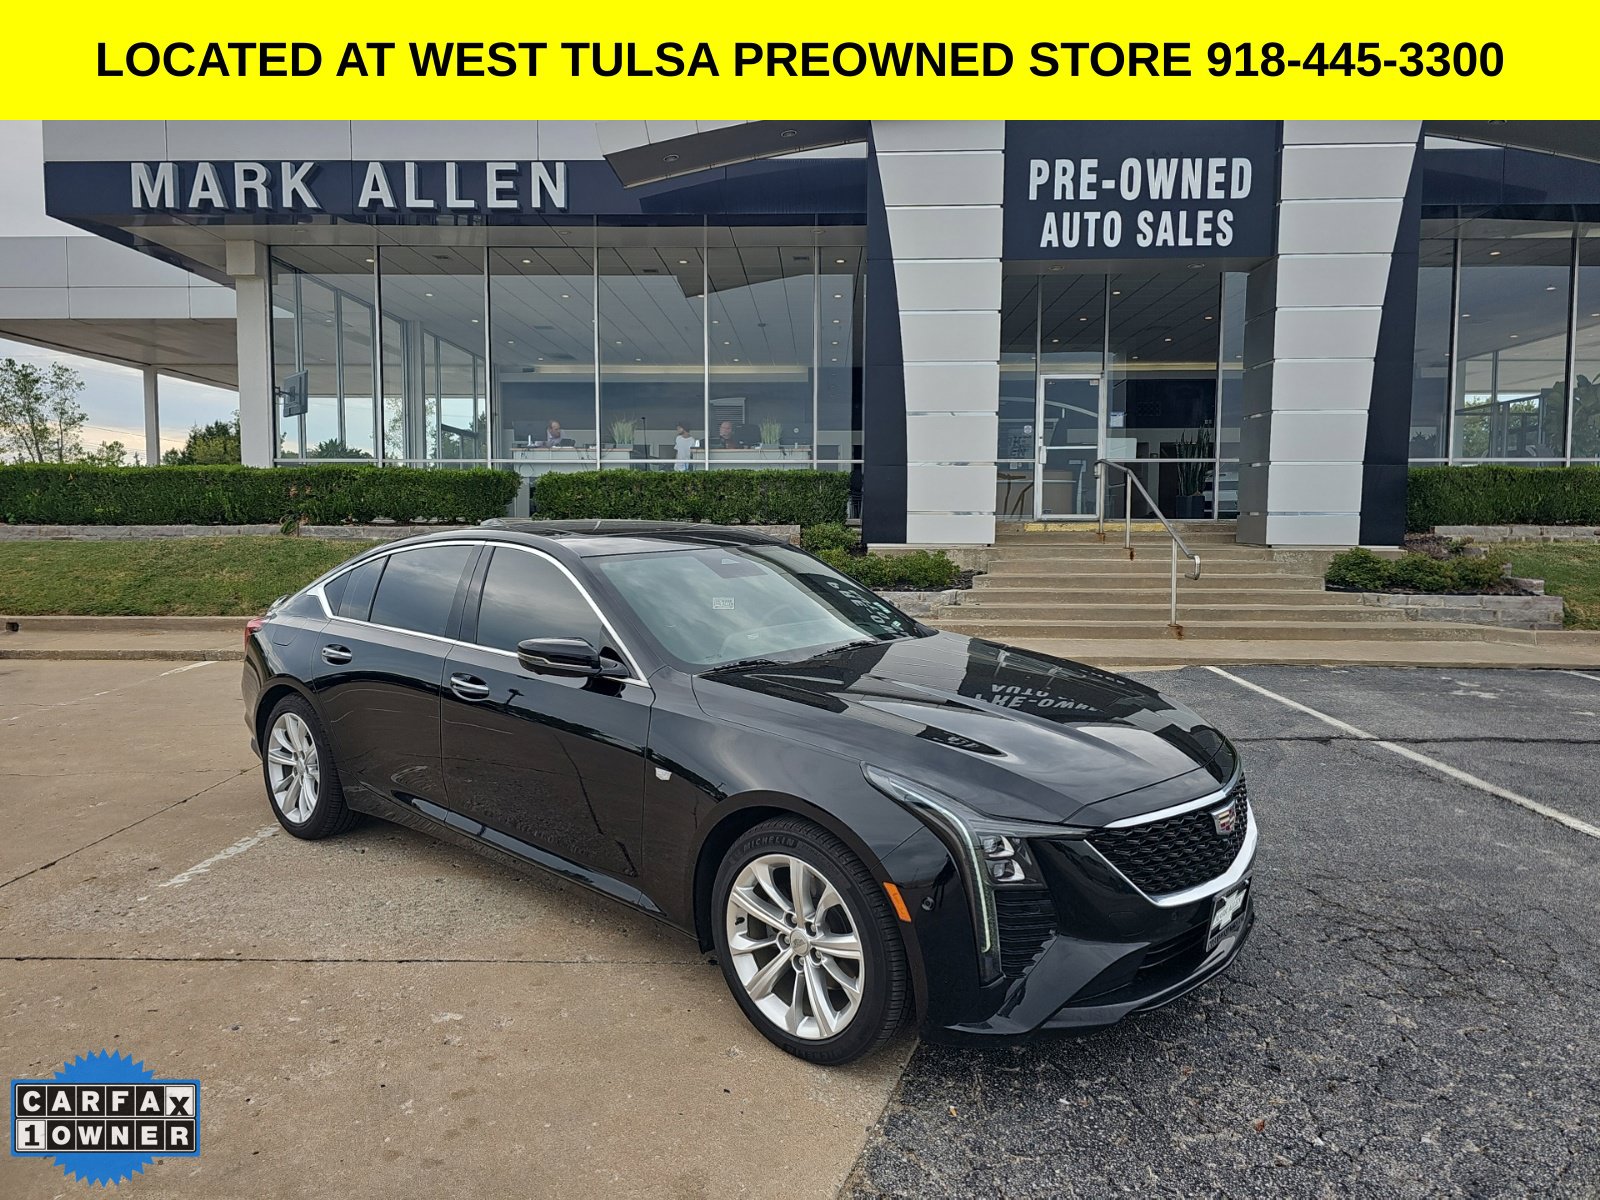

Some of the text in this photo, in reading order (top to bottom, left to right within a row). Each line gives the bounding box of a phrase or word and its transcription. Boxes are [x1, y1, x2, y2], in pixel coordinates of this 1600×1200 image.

[130, 161, 567, 209] MARK ALLEN
[1029, 157, 1252, 201] PRE-OWNED
[1040, 209, 1234, 248] AUTO SALES
[743, 836, 795, 852] MICHELIN
